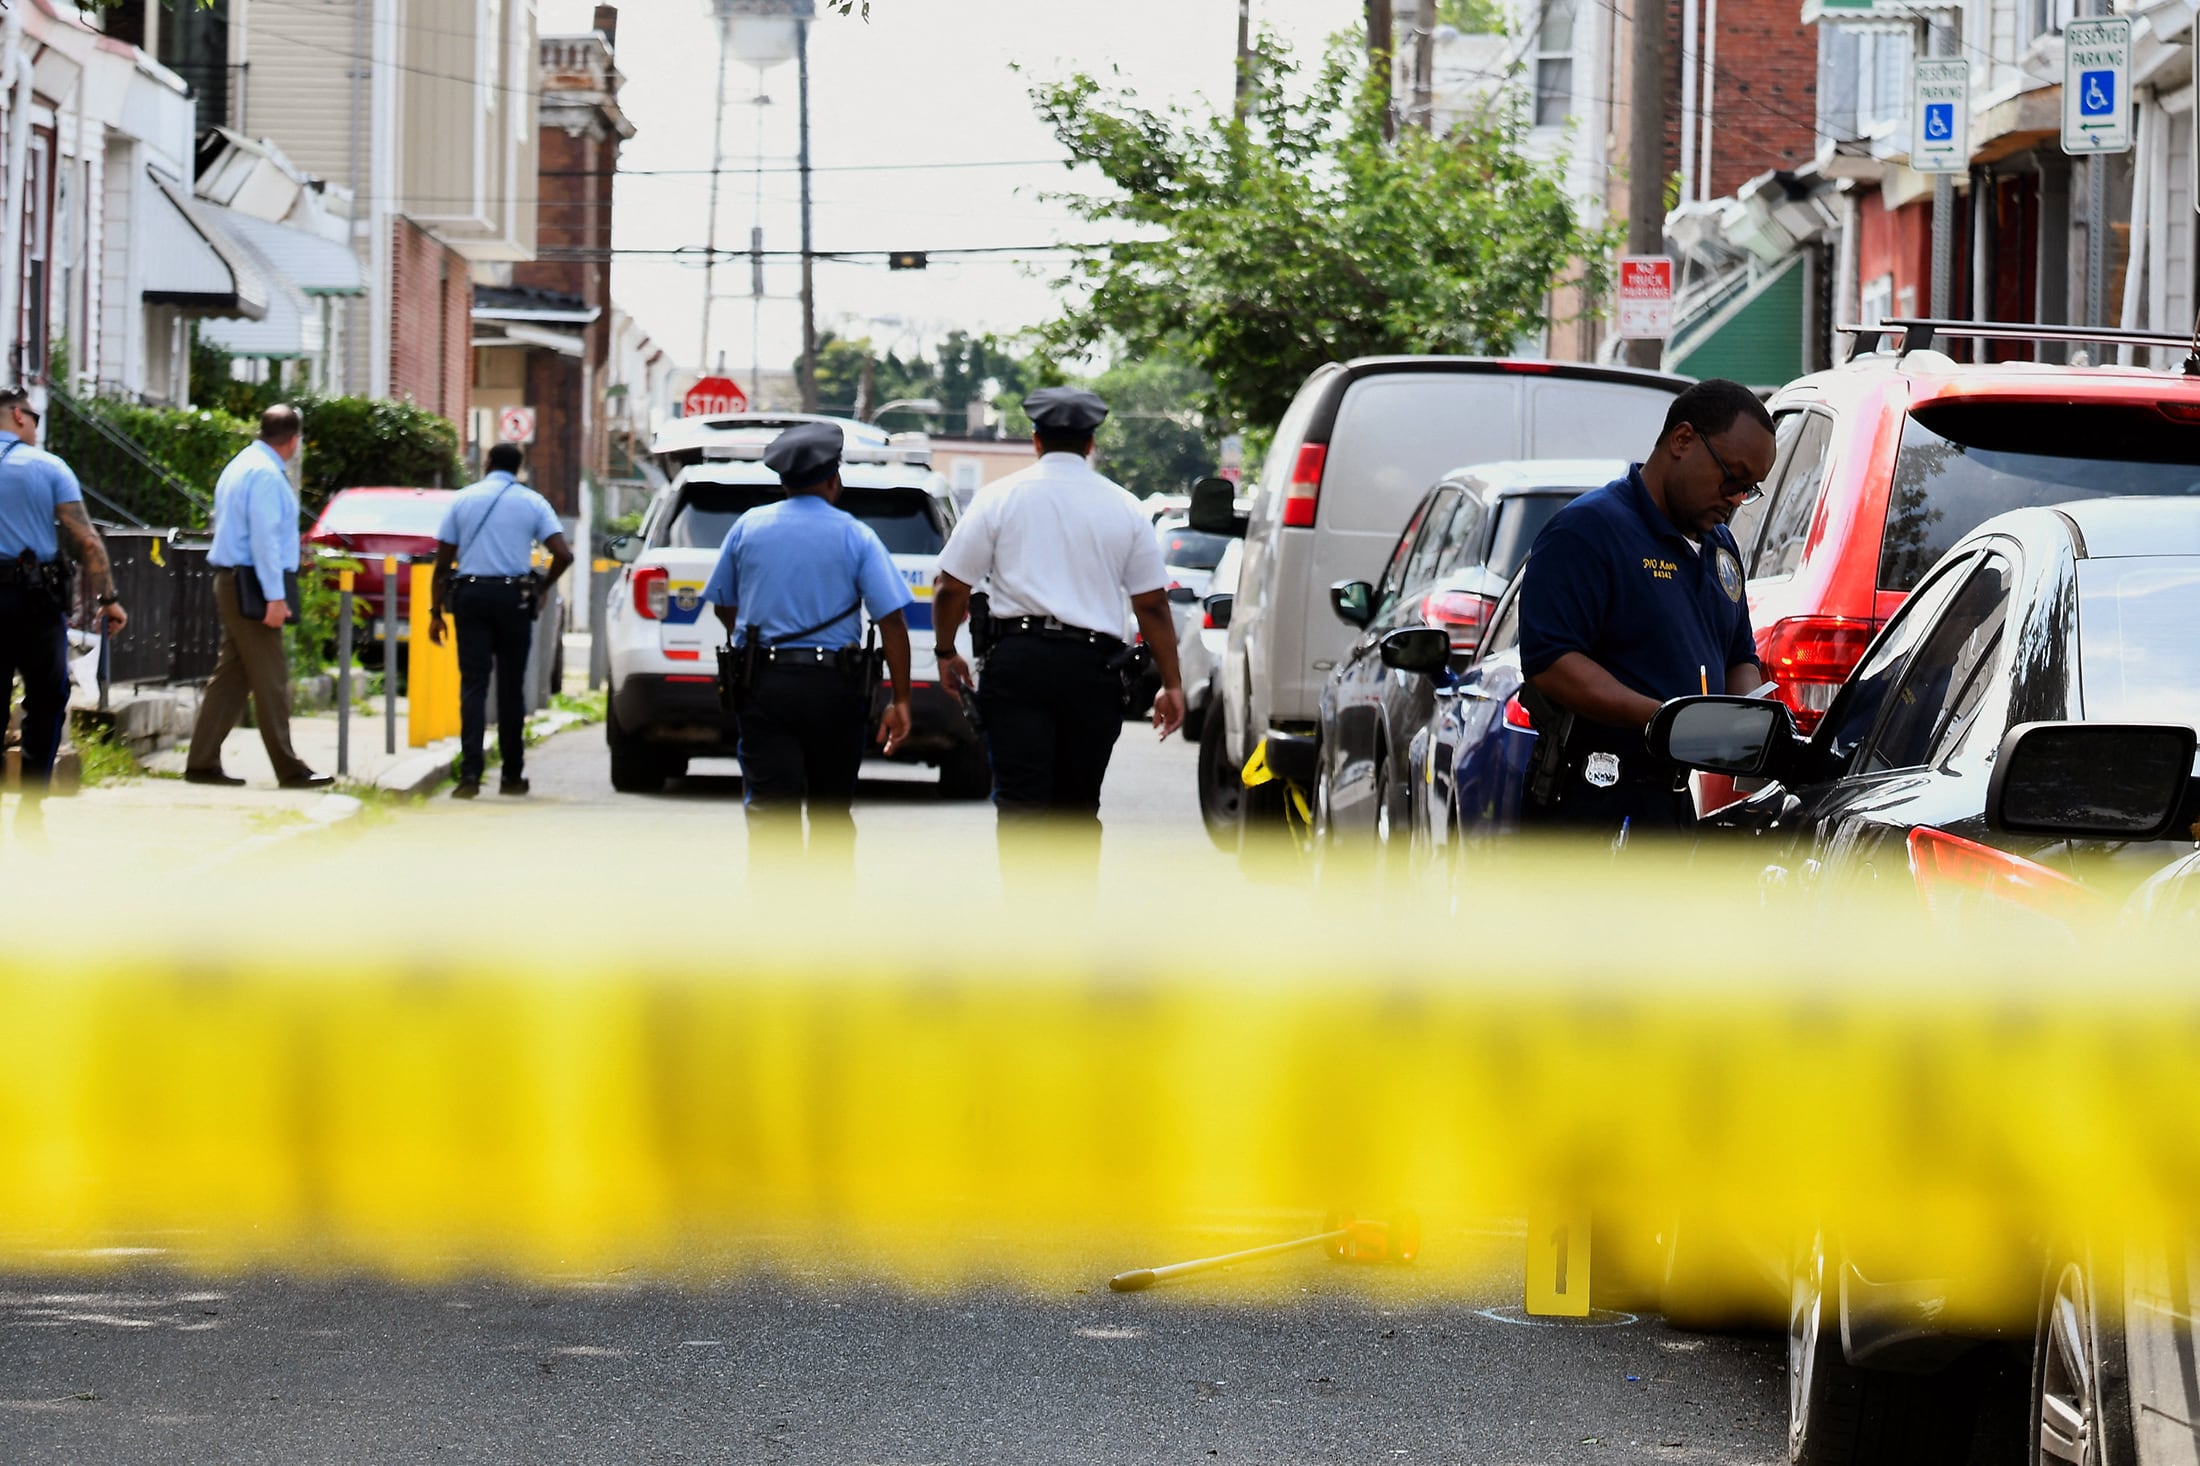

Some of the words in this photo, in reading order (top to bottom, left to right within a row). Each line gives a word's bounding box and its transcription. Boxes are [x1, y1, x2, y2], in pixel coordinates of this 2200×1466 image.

[2068, 27, 2126, 46] RESERVED
[2073, 48, 2123, 67] PARKING
[1917, 66, 1967, 81] RESERVED
[1920, 86, 1963, 99] PARKING
[1635, 262, 1655, 274] NO
[1628, 274, 1664, 287] TRUCK
[1623, 286, 1670, 299] PARKING
[685, 393, 748, 417] STOP
[1549, 1222, 1569, 1295] 1
